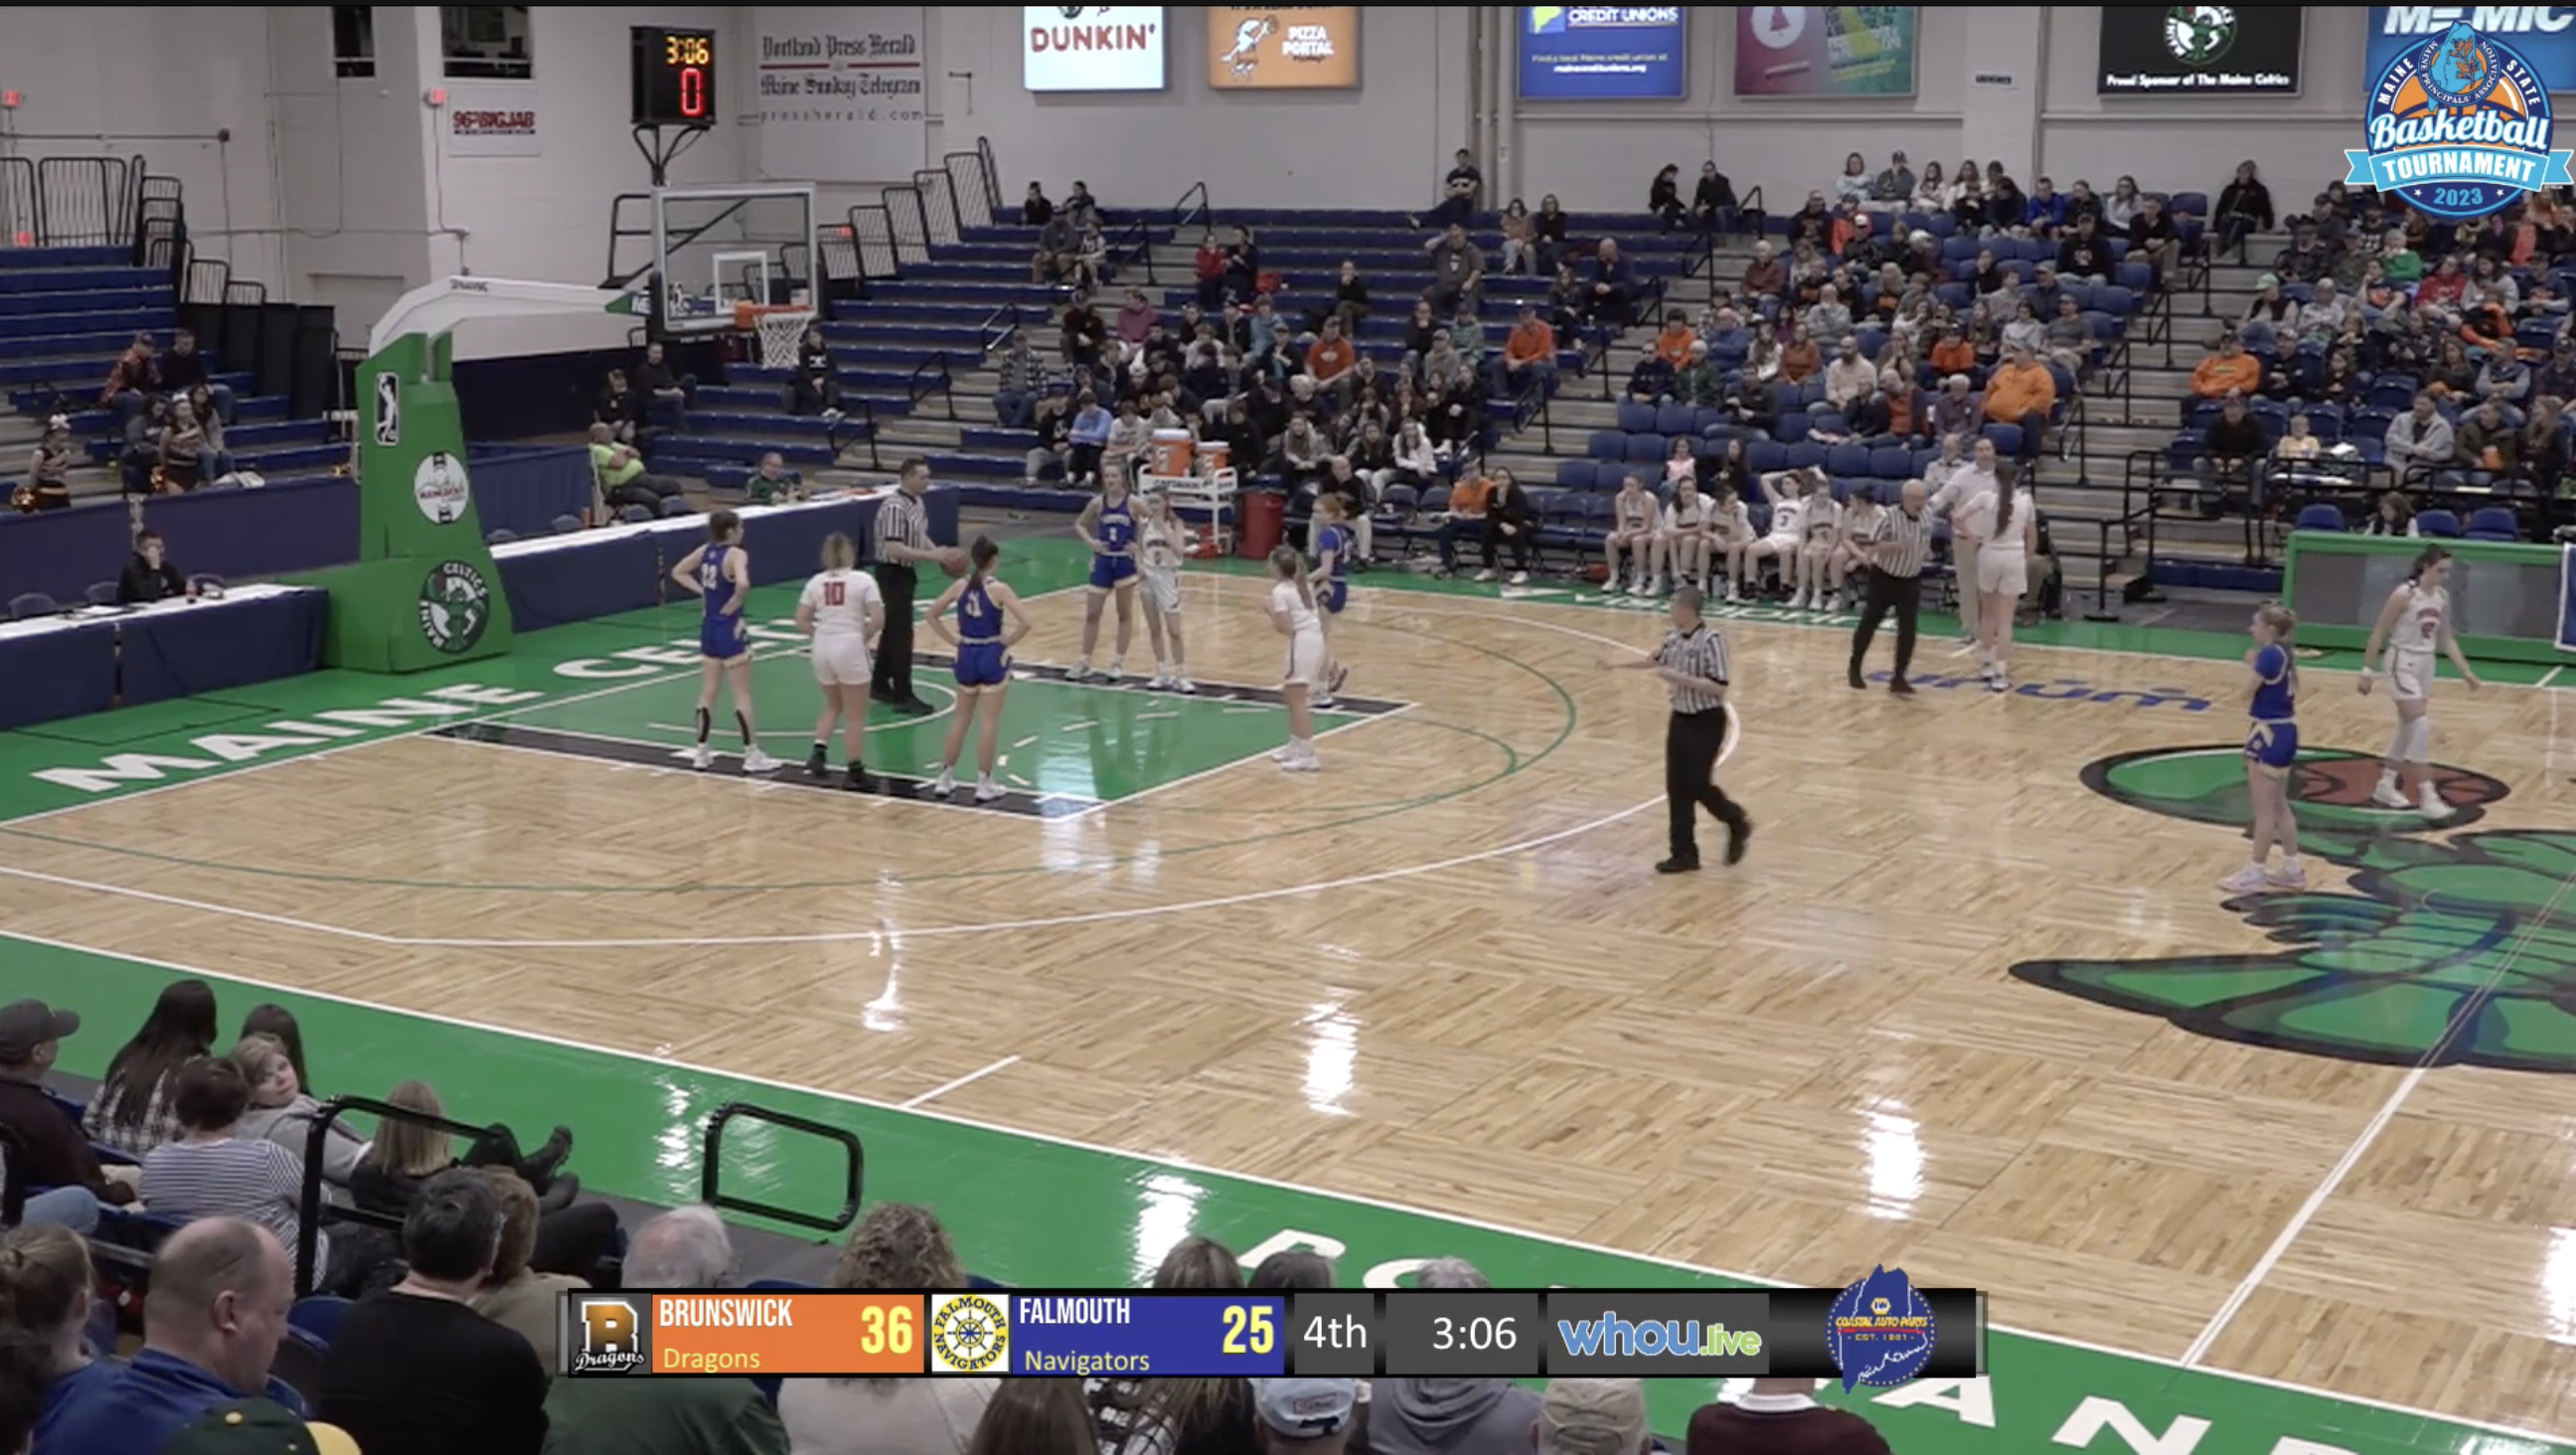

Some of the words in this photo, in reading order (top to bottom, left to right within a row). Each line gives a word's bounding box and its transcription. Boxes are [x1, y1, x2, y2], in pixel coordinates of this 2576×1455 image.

[1568, 8, 1618, 23] CREDIT
[1620, 7, 1679, 21] UNIONS
[1031, 24, 1156, 53] DUNKIN'
[1288, 26, 1327, 41] PIZZA
[666, 36, 710, 65] 3:06
[762, 36, 821, 59] Portland
[826, 35, 865, 59] Press
[869, 34, 915, 58] Herald
[1282, 41, 1334, 56] PORTAL
[680, 67, 702, 115] 0
[760, 75, 799, 95] Maine
[805, 75, 856, 99] Sunday
[860, 73, 921, 97] Telegram
[2107, 75, 2136, 85] Proud
[2139, 75, 2180, 87] Sponsor
[2182, 75, 2194, 85] of
[2197, 75, 2216, 85] The
[2219, 75, 2252, 85] Maine
[2255, 74, 2290, 85] Celtics
[443, 563, 488, 597] CELTICS
[823, 581, 845, 606] 10
[31, 682, 545, 793] MAINE
